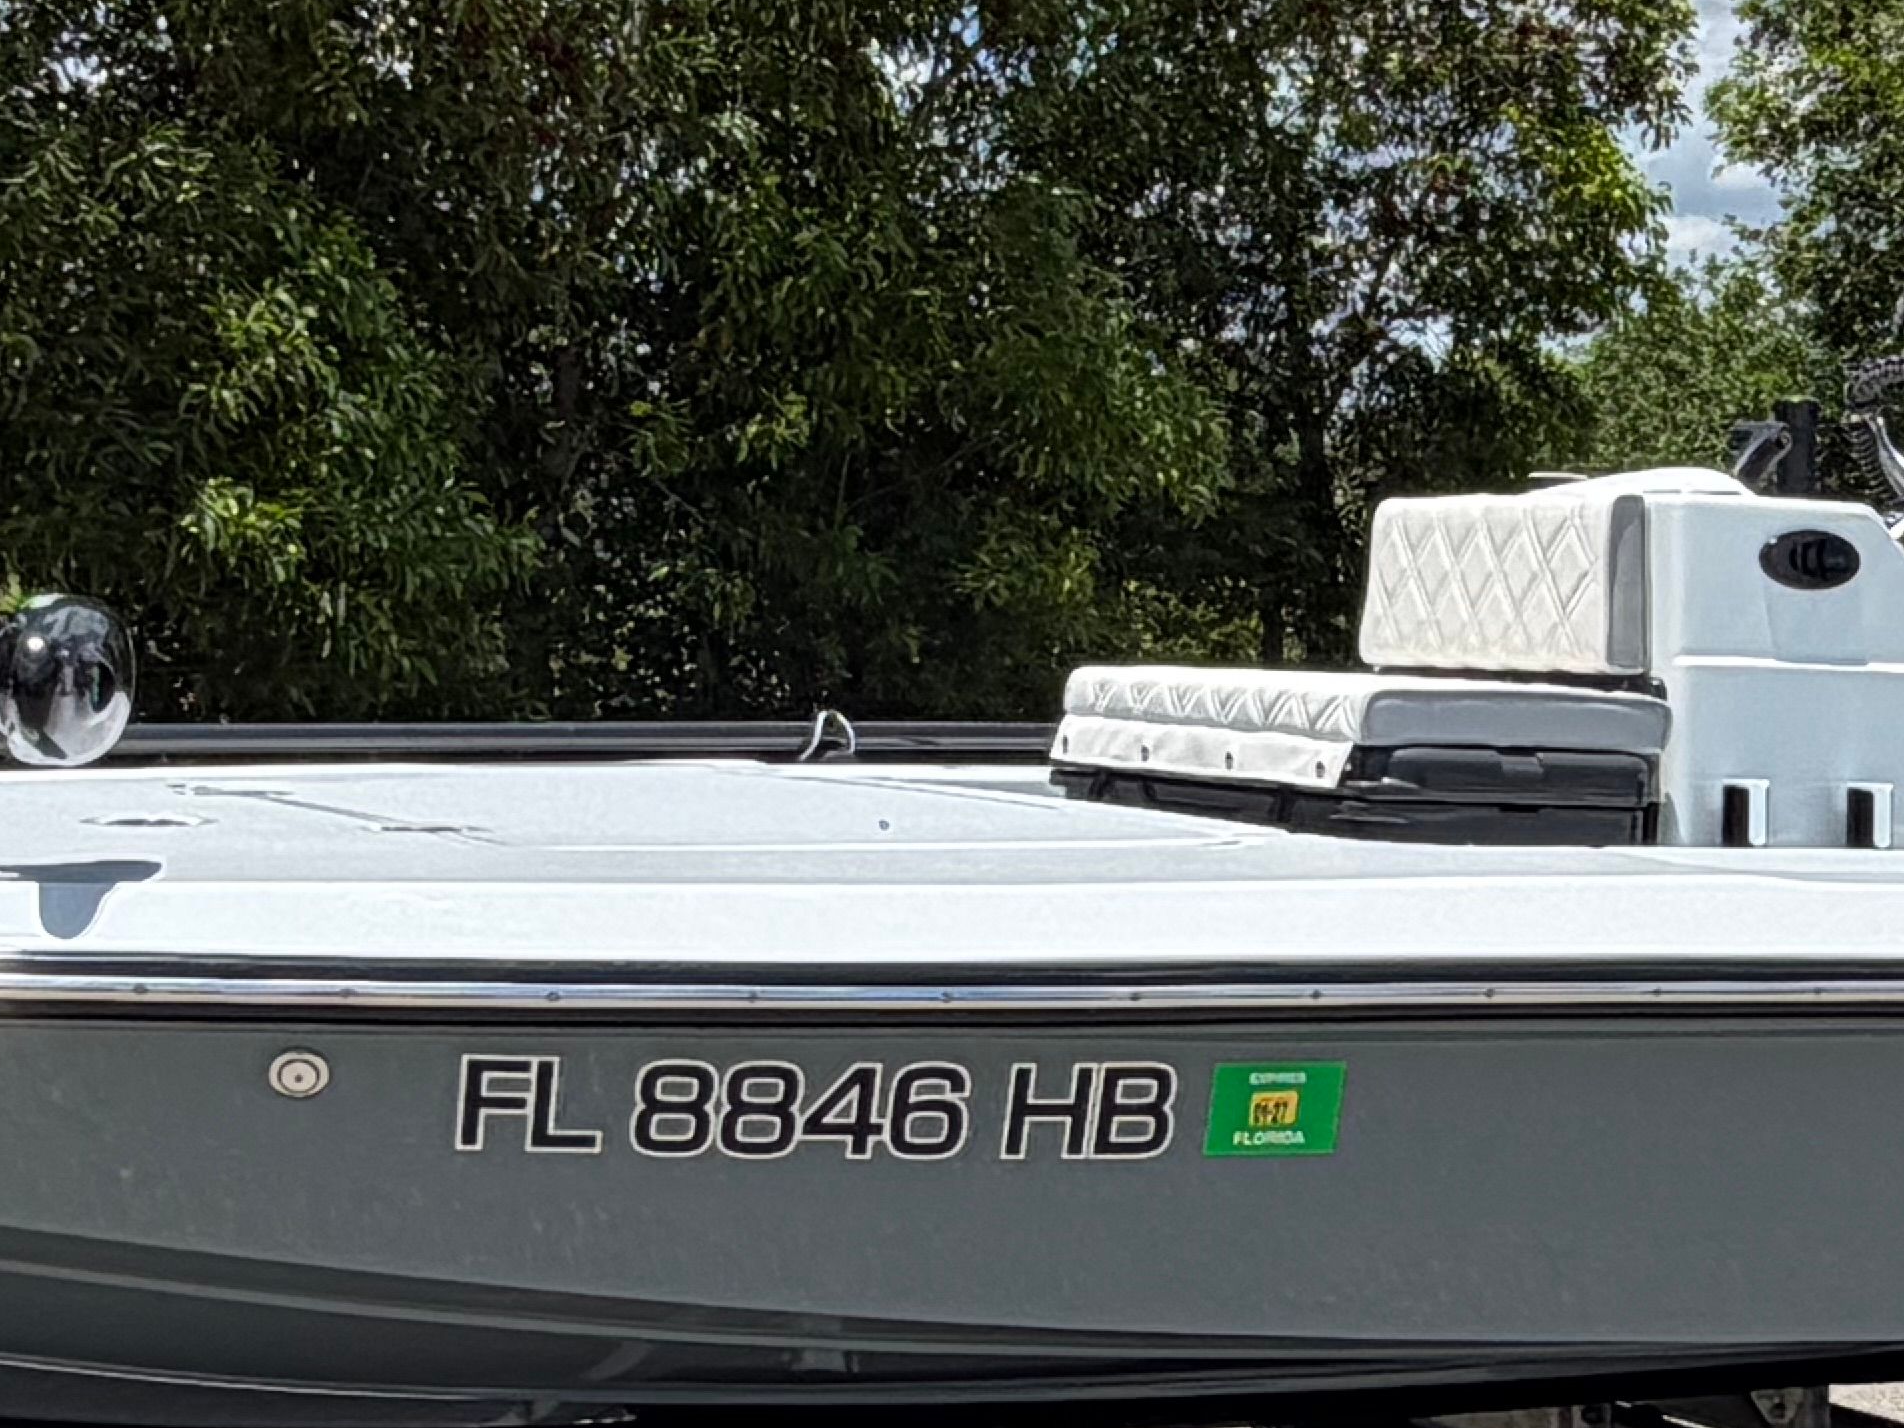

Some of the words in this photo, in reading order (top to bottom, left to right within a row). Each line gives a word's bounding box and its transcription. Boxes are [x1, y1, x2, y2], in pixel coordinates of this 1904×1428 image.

[455, 1054, 603, 1153] FL
[628, 1059, 971, 1160] 8846
[999, 1061, 1177, 1160] HB
